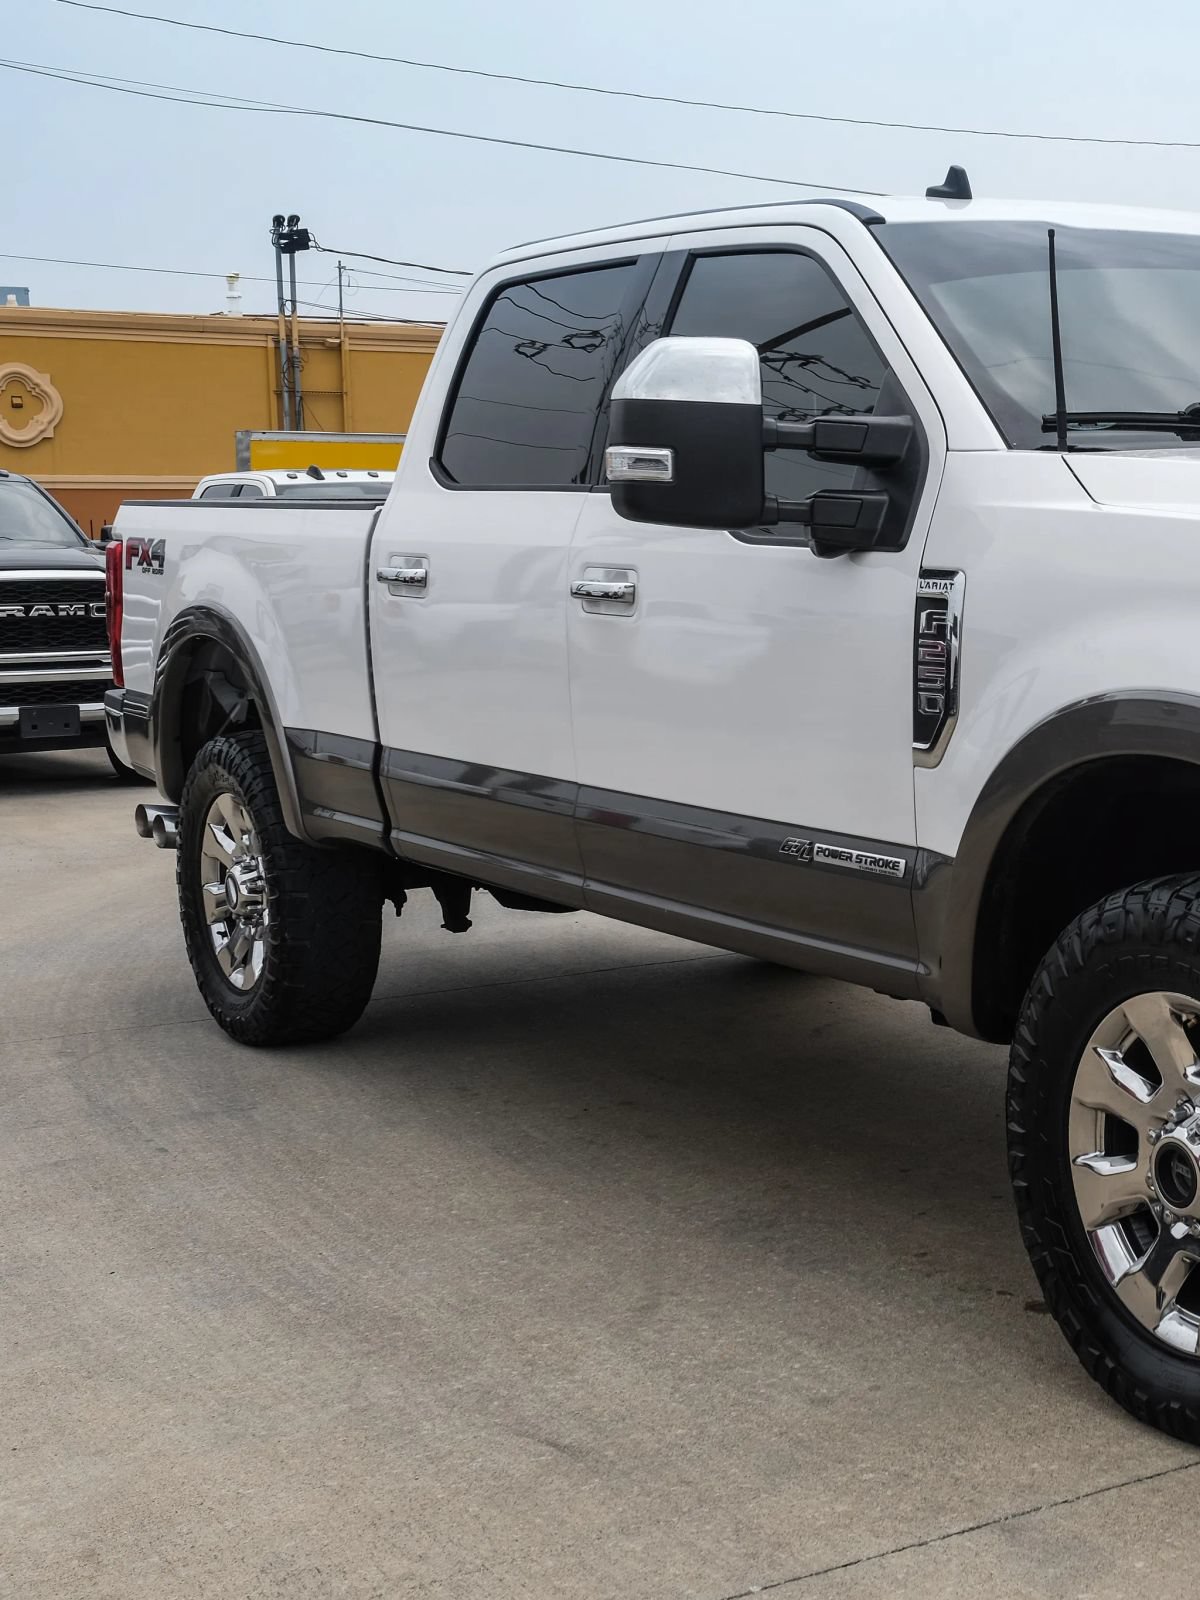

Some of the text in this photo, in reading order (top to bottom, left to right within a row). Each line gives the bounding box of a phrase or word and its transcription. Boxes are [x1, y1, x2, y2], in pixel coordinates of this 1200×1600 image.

[125, 537, 166, 570] FX4
[919, 579, 955, 591] LARIAT
[0, 605, 85, 617] RAM
[815, 846, 900, 871] POWER STROKE
